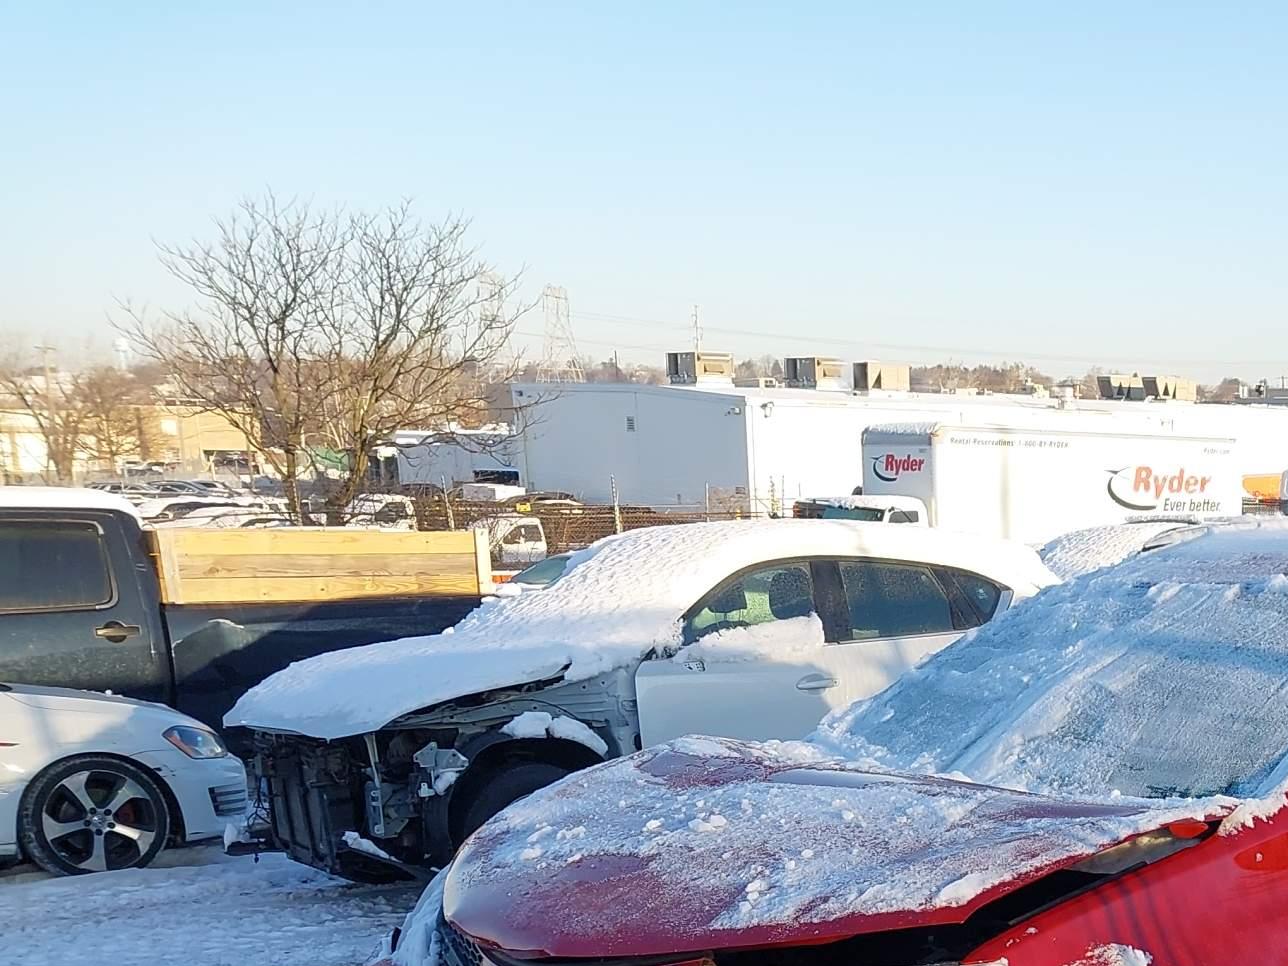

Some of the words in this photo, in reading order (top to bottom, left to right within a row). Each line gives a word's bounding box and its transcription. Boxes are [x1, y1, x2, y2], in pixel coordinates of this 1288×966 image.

[884, 454, 925, 476] Ryder
[1133, 466, 1212, 500] Ryder
[1163, 498, 1186, 512] Ever
